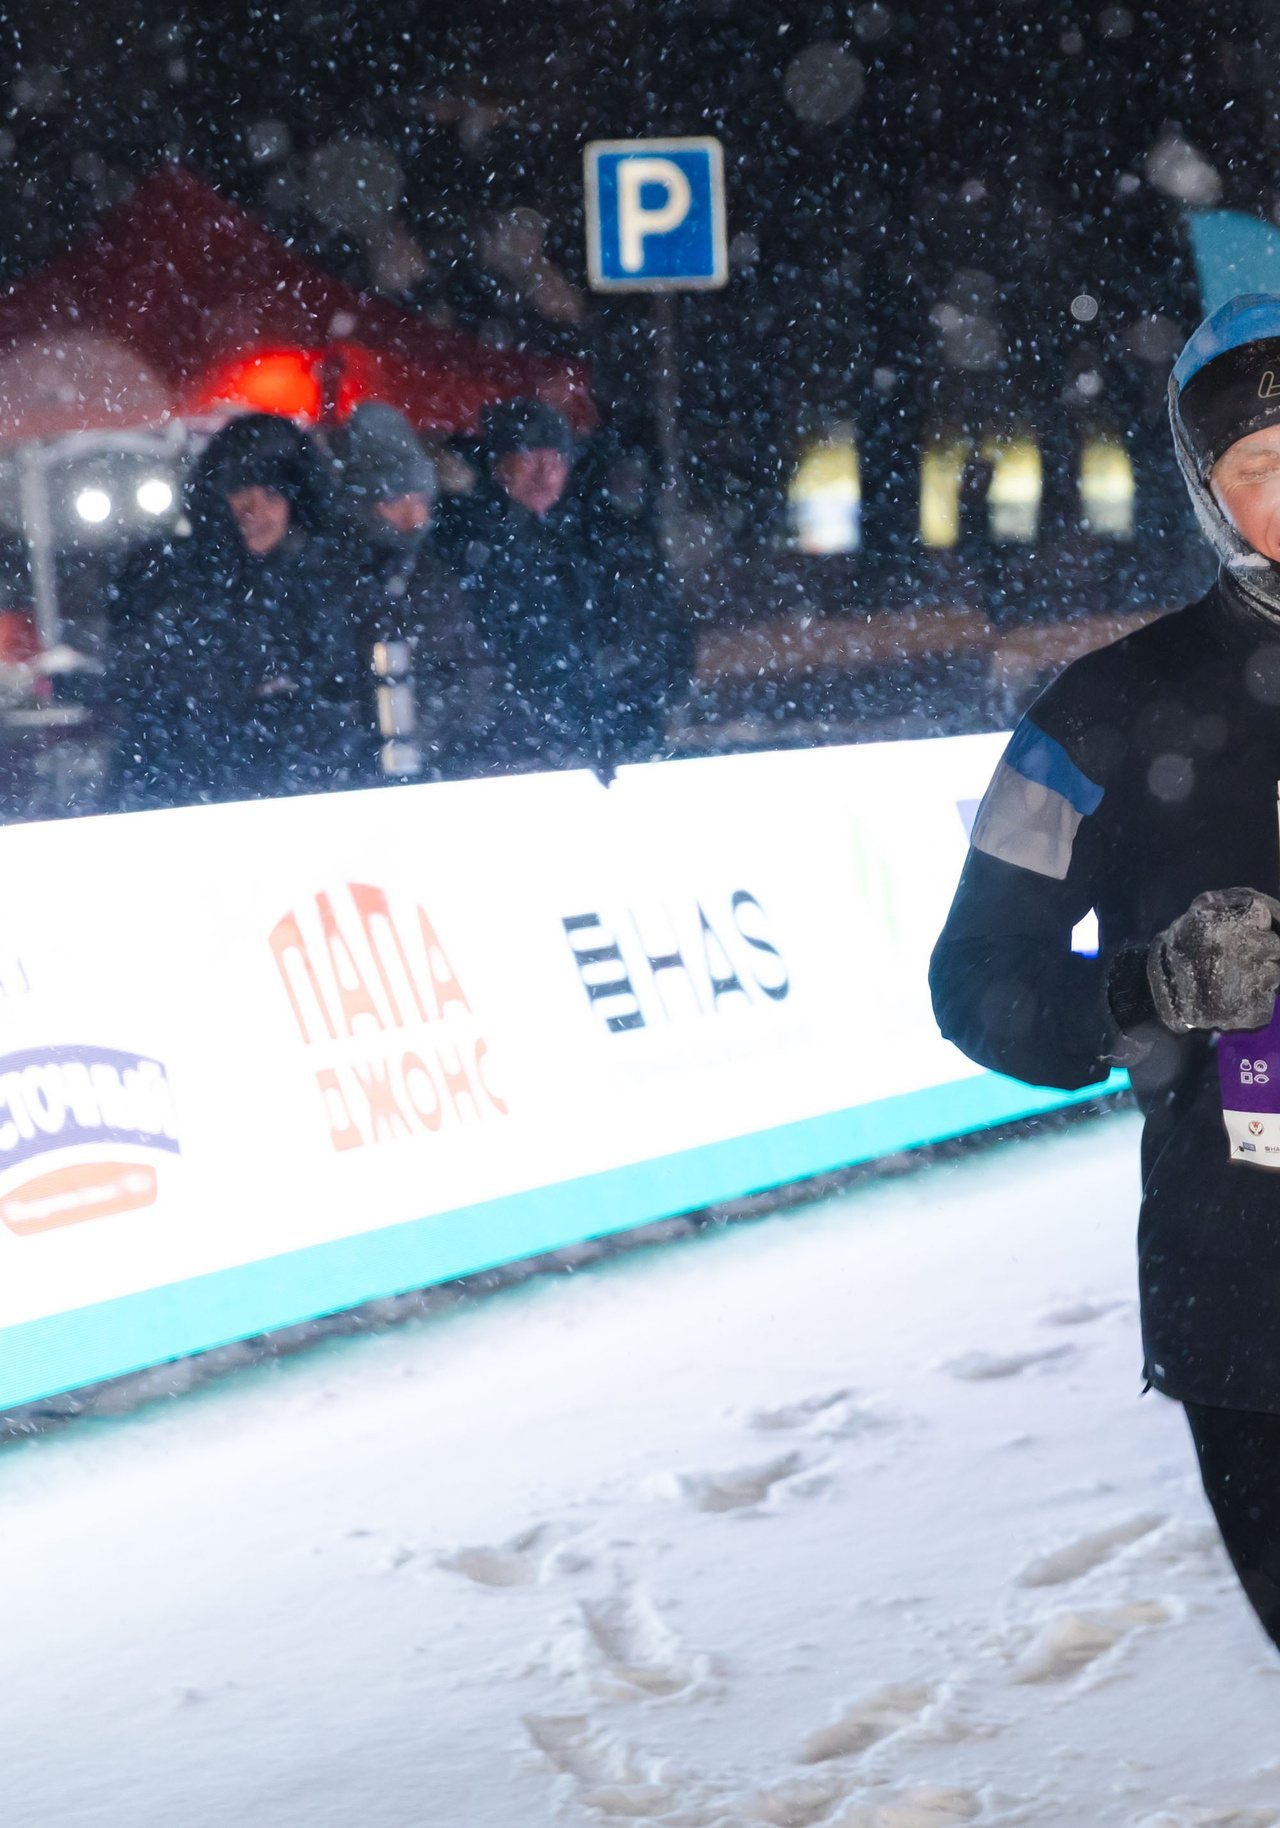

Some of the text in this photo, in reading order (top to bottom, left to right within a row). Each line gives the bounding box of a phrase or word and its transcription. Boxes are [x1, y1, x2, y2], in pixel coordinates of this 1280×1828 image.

[617, 157, 692, 273] P
[268, 881, 472, 1045] ПАПА
[314, 1037, 509, 1152] ДЖОНС
